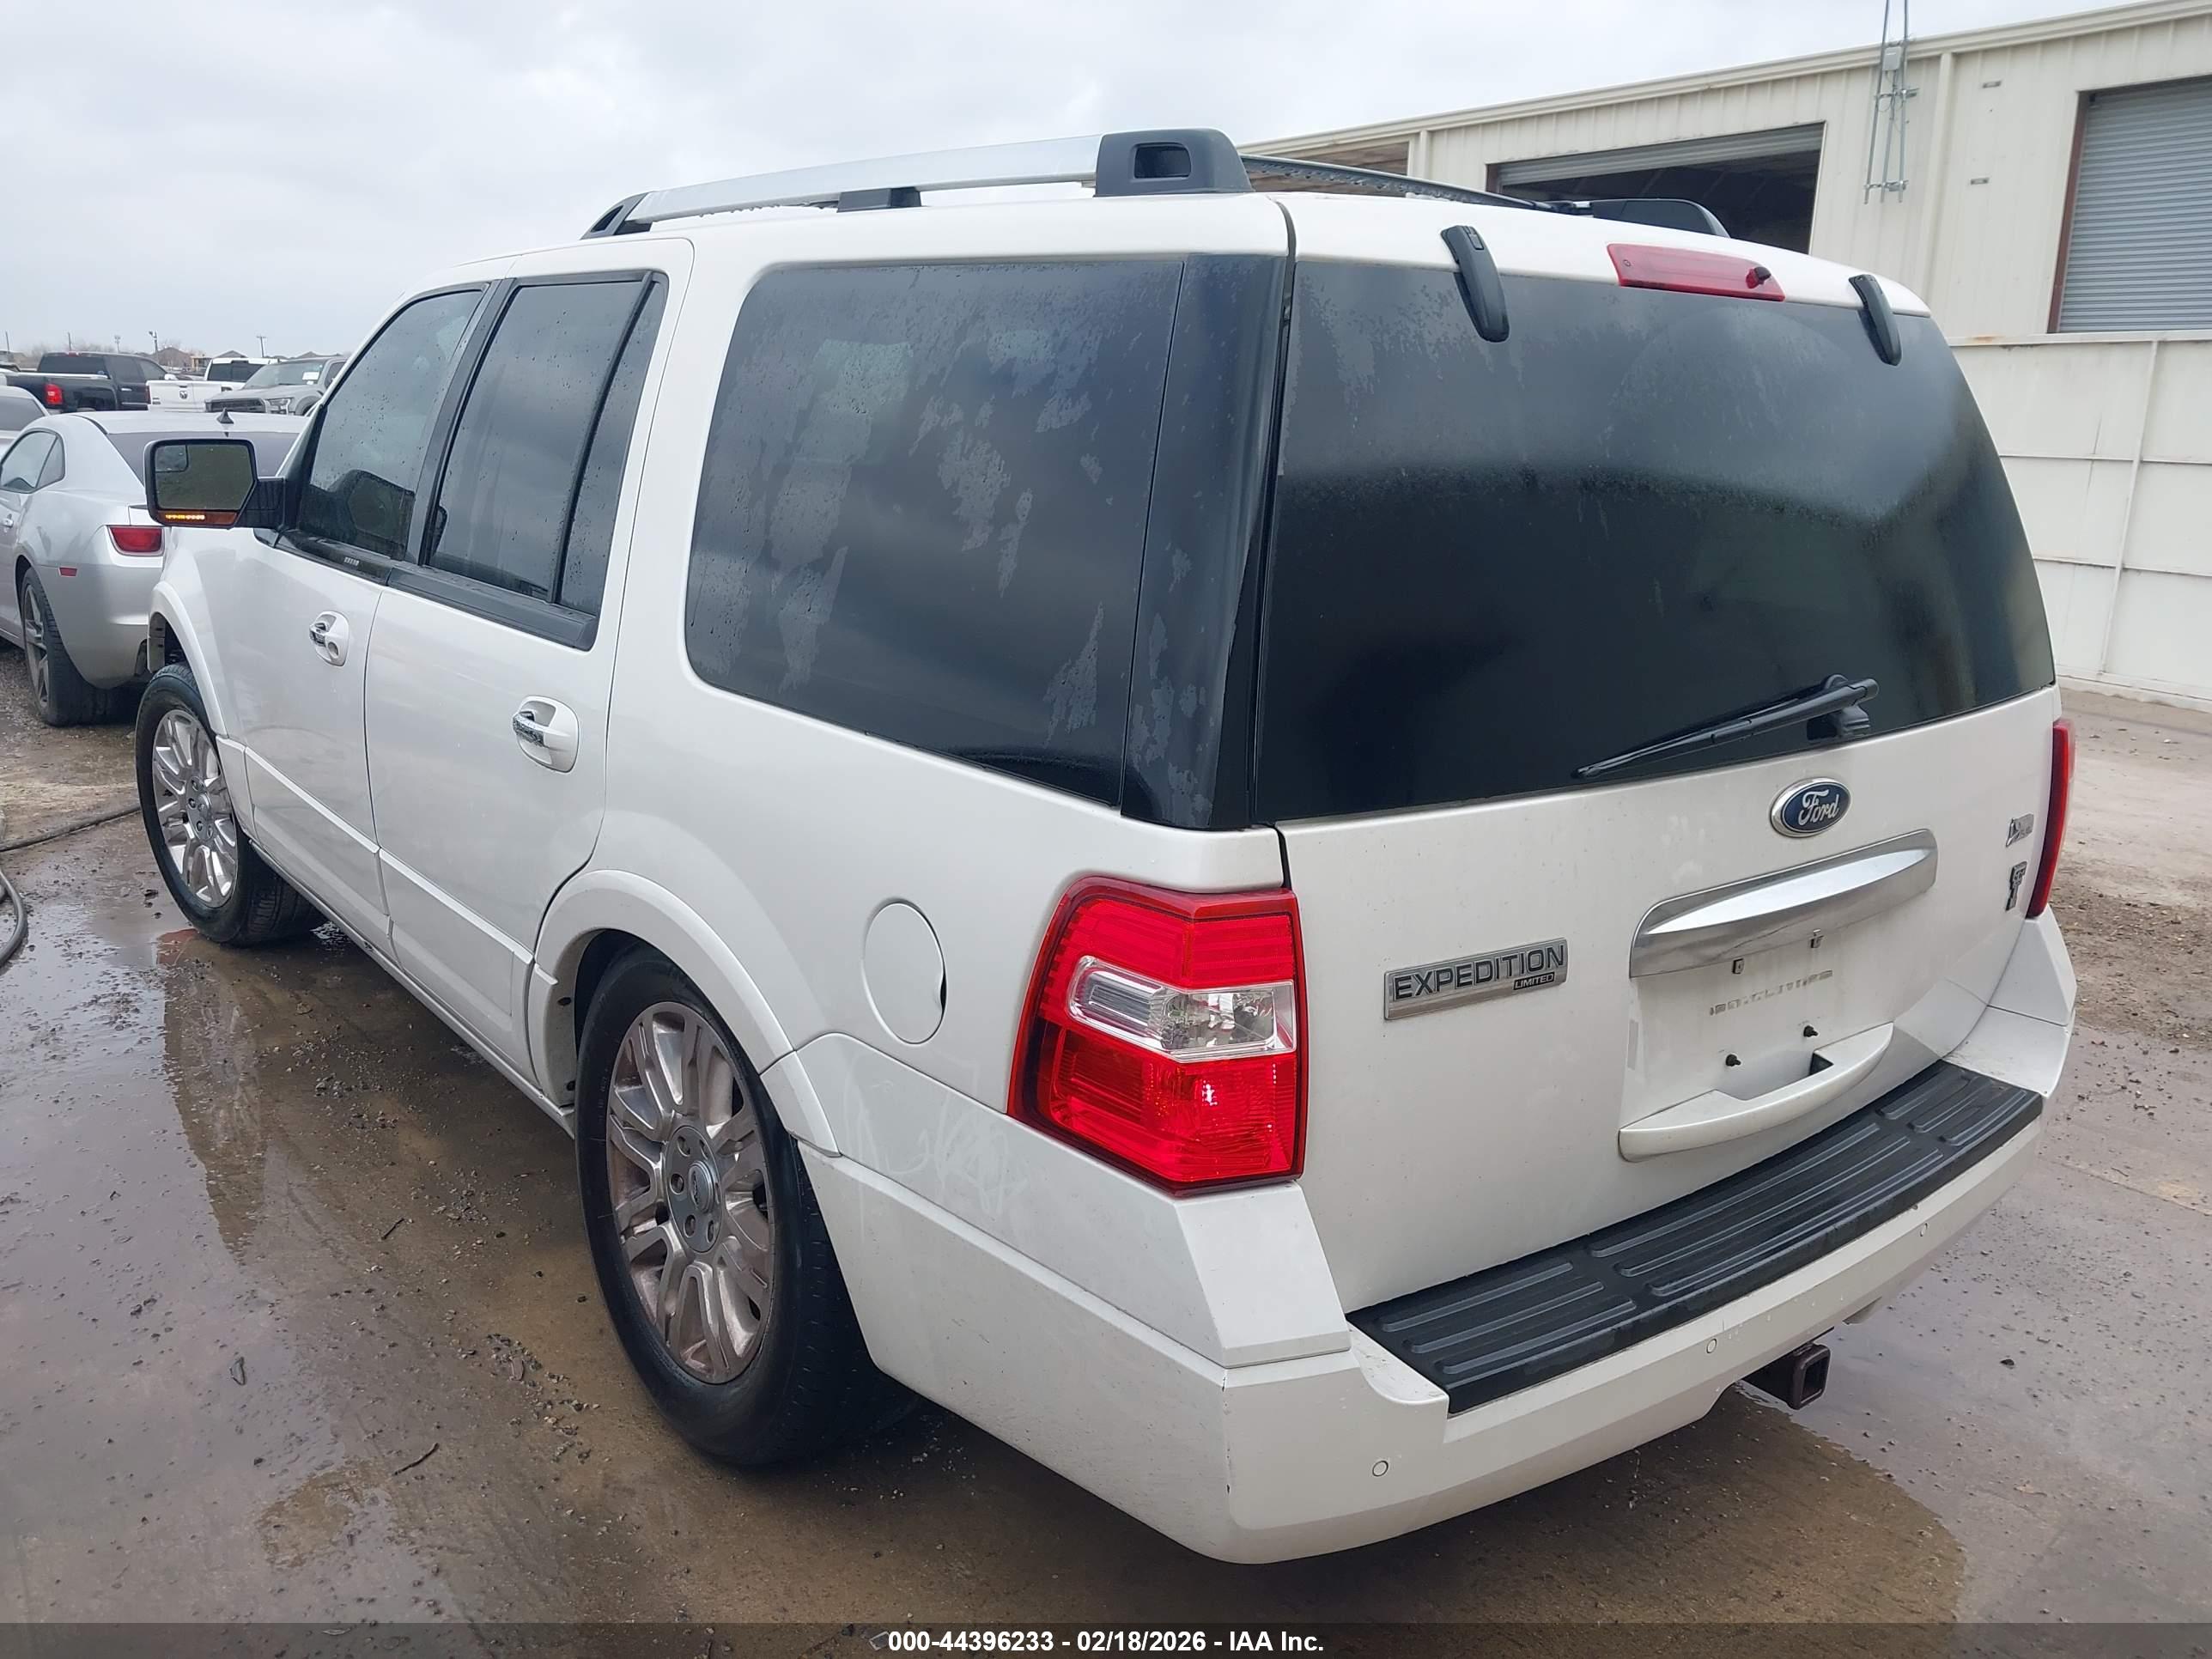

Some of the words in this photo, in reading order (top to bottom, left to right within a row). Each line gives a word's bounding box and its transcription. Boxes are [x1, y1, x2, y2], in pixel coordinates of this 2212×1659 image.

[1797, 788, 1839, 826] Ford
[1394, 945, 1565, 1000] EXPEDITION
[1514, 972, 1555, 990] LIMITED
